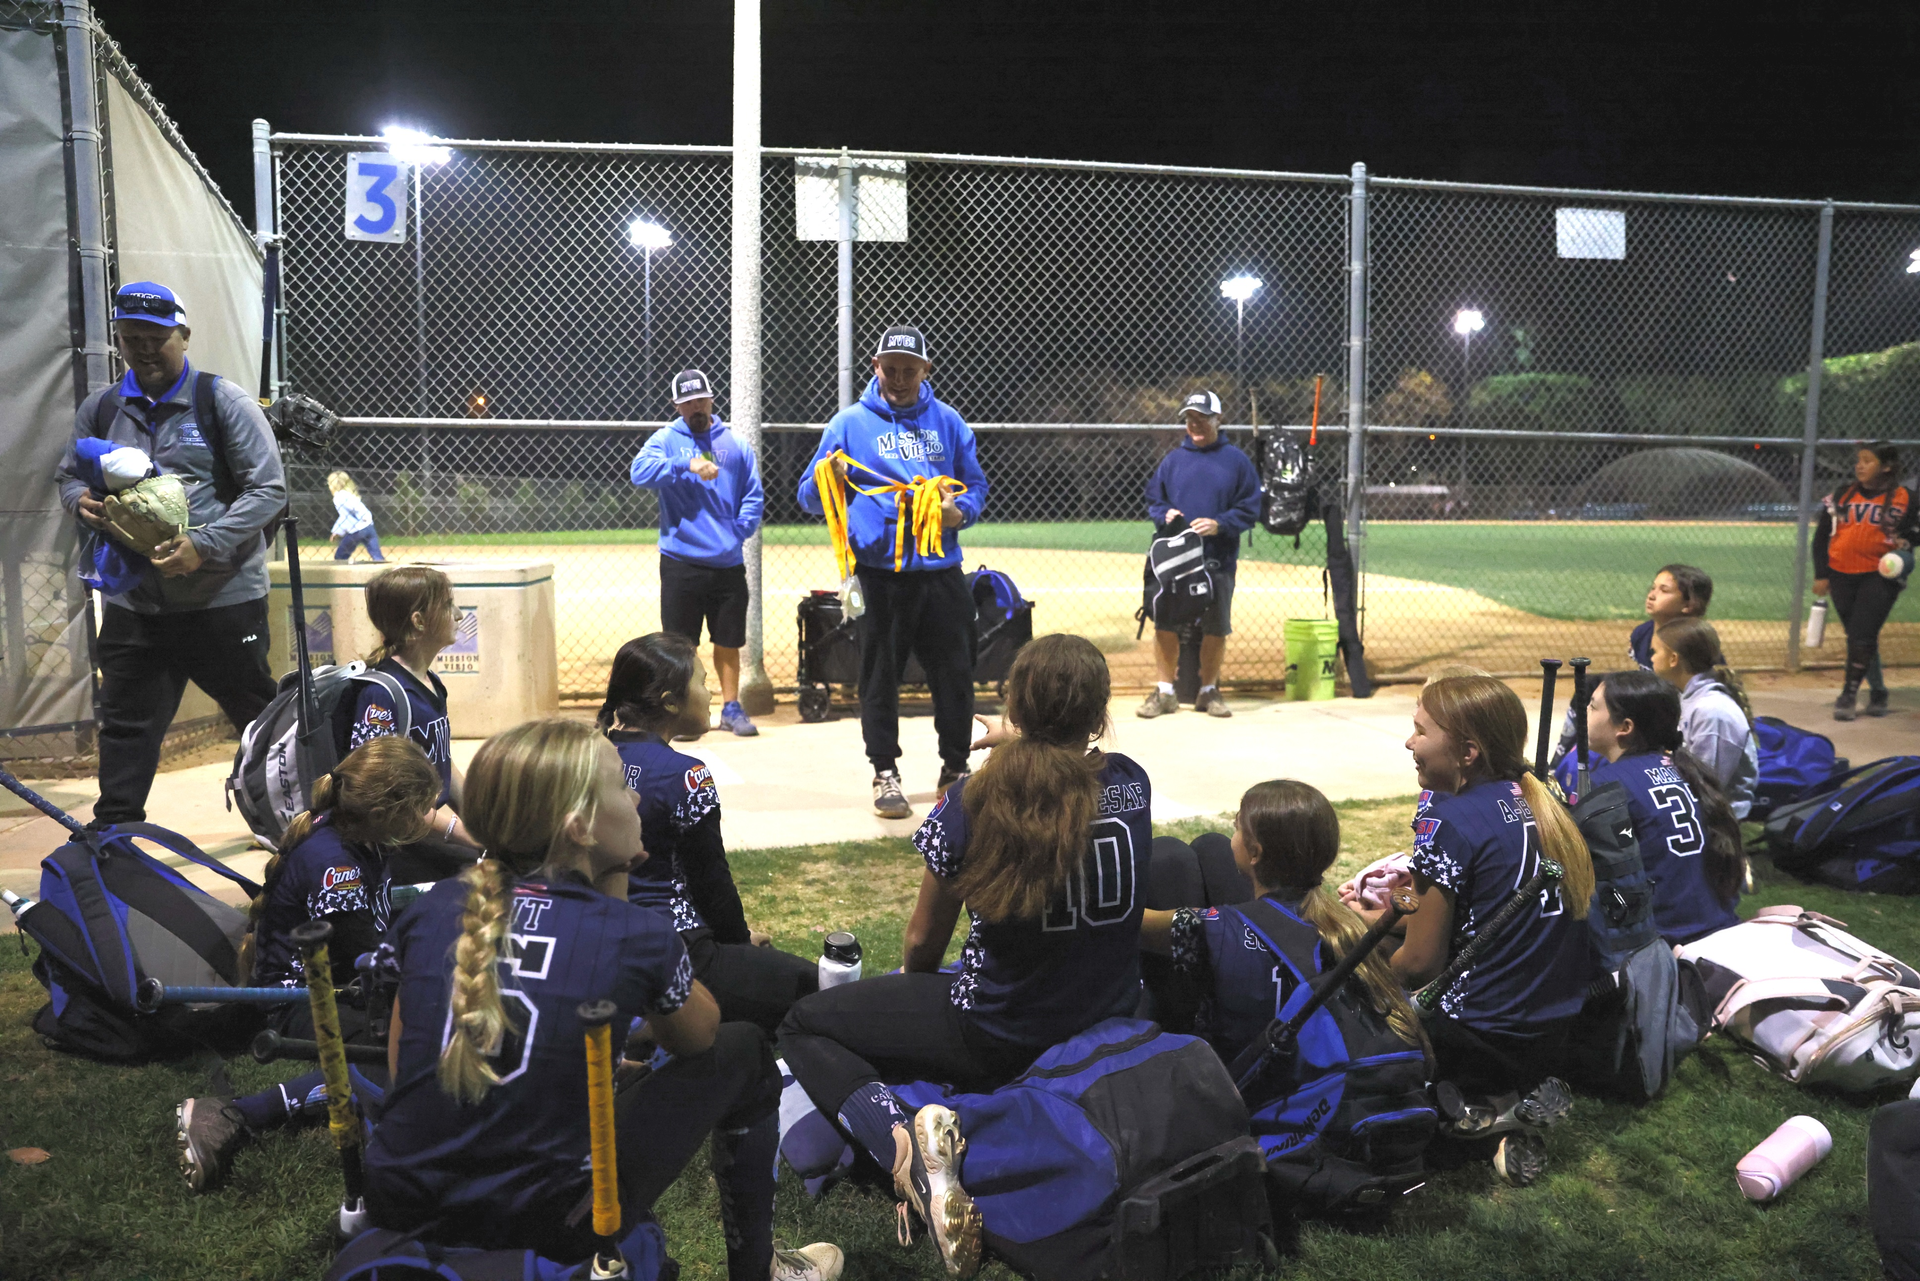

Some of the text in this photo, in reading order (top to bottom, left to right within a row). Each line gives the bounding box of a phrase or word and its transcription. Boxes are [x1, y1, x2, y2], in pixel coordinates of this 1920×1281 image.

[353, 162, 398, 235] 3
[437, 655, 479, 663] MISSION
[444, 663, 474, 671] VIEJO
[278, 742, 295, 812] EASTON
[323, 866, 361, 890] Cane's
[1042, 817, 1136, 932] 10
